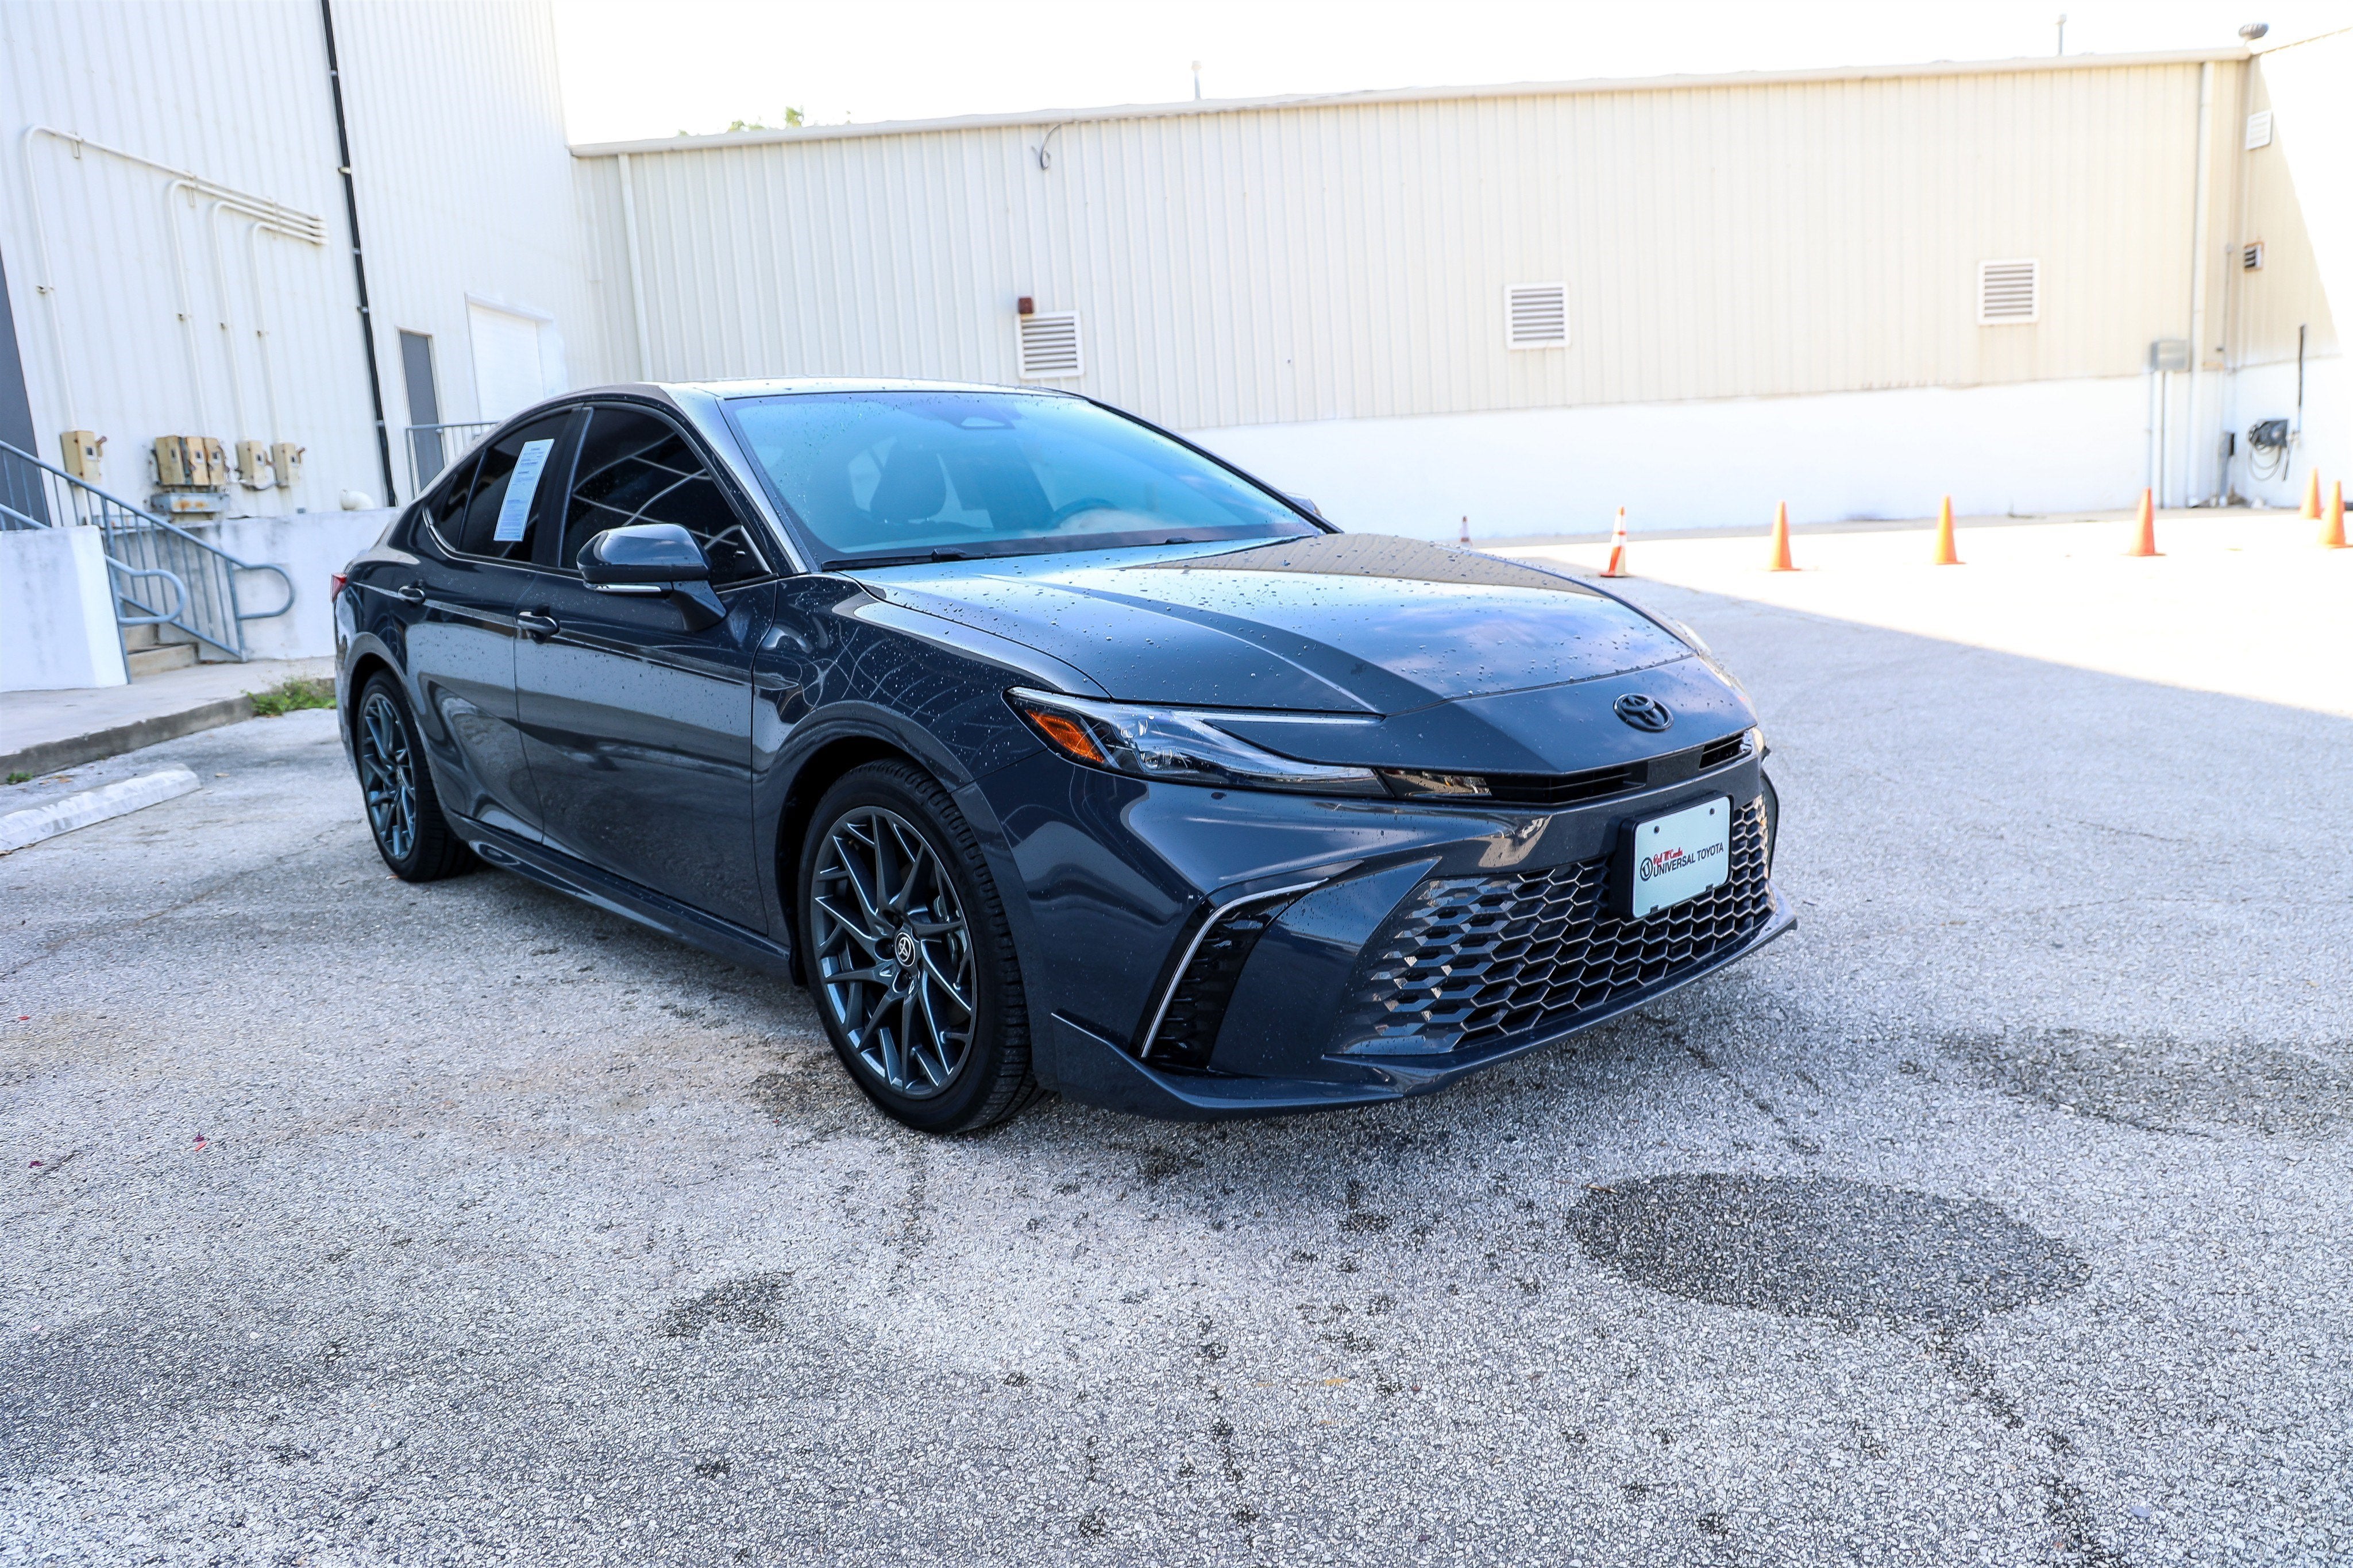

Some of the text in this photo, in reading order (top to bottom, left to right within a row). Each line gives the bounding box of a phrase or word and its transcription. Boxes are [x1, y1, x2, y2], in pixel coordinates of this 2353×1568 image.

[1653, 842, 1724, 877] UNIVERSAL TOYOTA
[1663, 847, 1683, 861] MCbs
